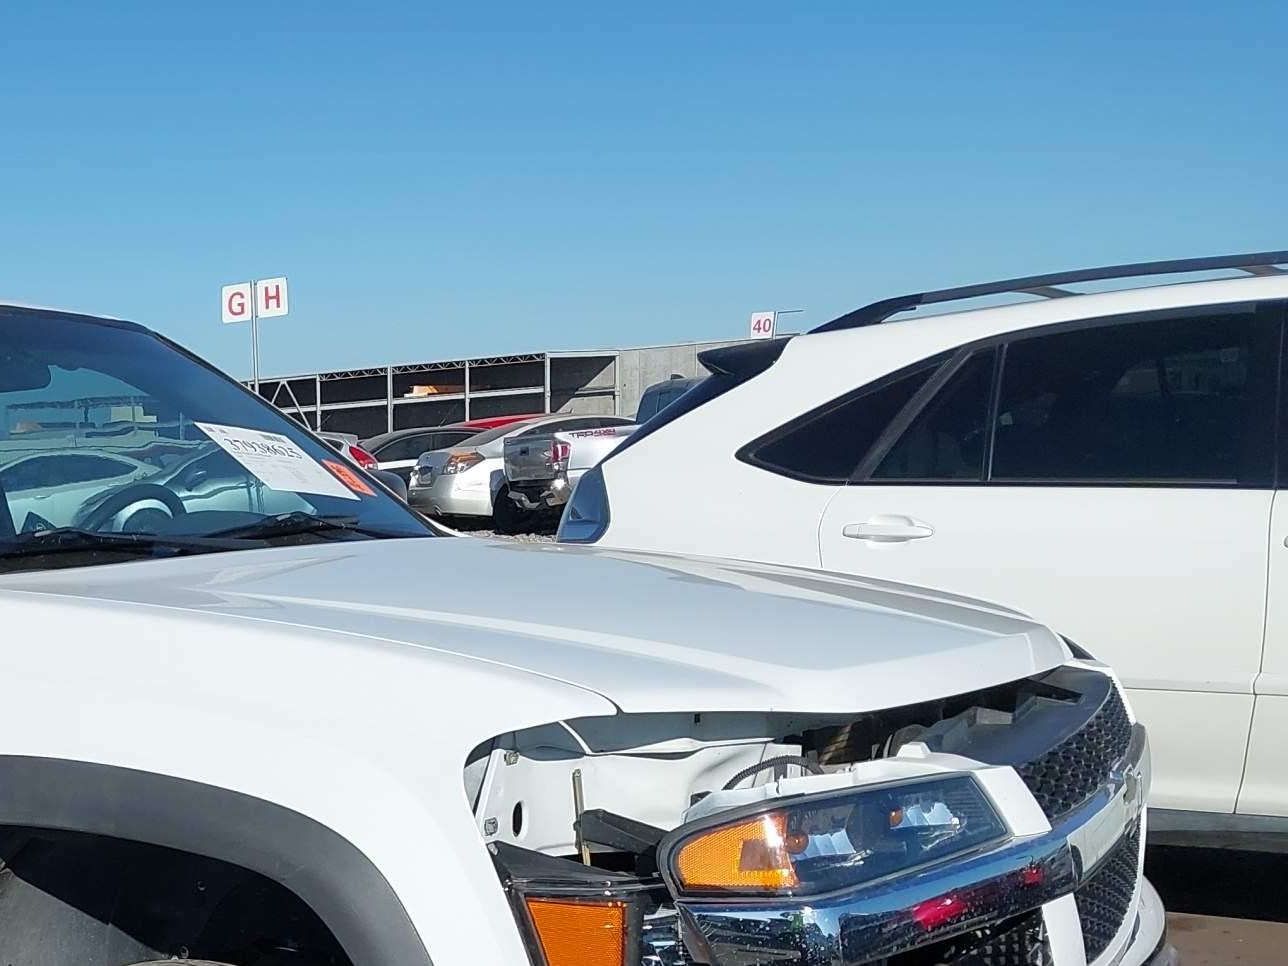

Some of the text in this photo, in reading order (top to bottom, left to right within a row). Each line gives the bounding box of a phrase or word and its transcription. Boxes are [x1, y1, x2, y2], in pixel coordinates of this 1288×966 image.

[228, 291, 245, 316] G
[264, 284, 281, 310] H
[752, 318, 772, 334] 40
